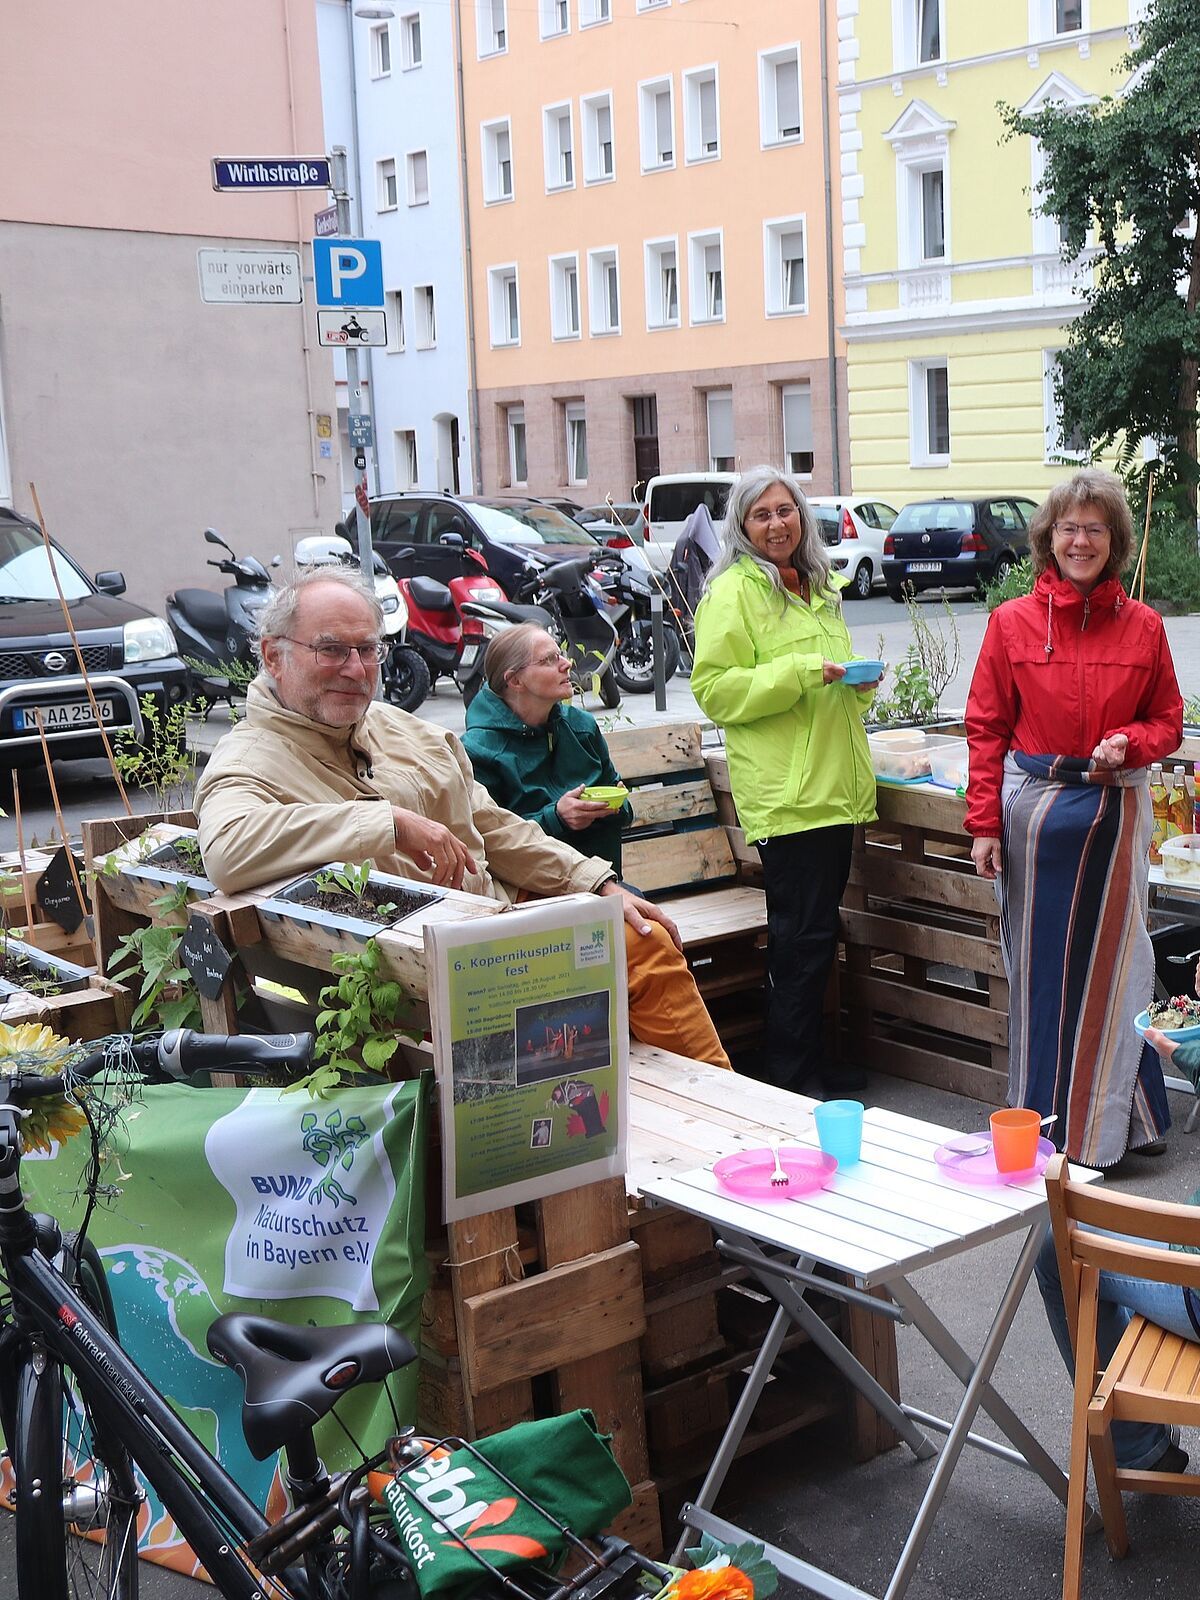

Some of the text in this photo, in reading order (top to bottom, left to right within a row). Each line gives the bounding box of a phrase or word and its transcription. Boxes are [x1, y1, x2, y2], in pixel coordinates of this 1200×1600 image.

[227, 163, 319, 184] Wirthstraße
[207, 260, 293, 275] nur vorwärts
[329, 247, 367, 298] P
[221, 281, 284, 298] einparken
[48, 707, 69, 724] AA
[454, 942, 573, 972] 6. Kopernikusplatz
[505, 964, 529, 977] fest
[250, 1175, 313, 1201] BUND
[253, 1203, 369, 1237] Naturschutz
[246, 1233, 259, 1260] in
[263, 1239, 338, 1270] Bayern
